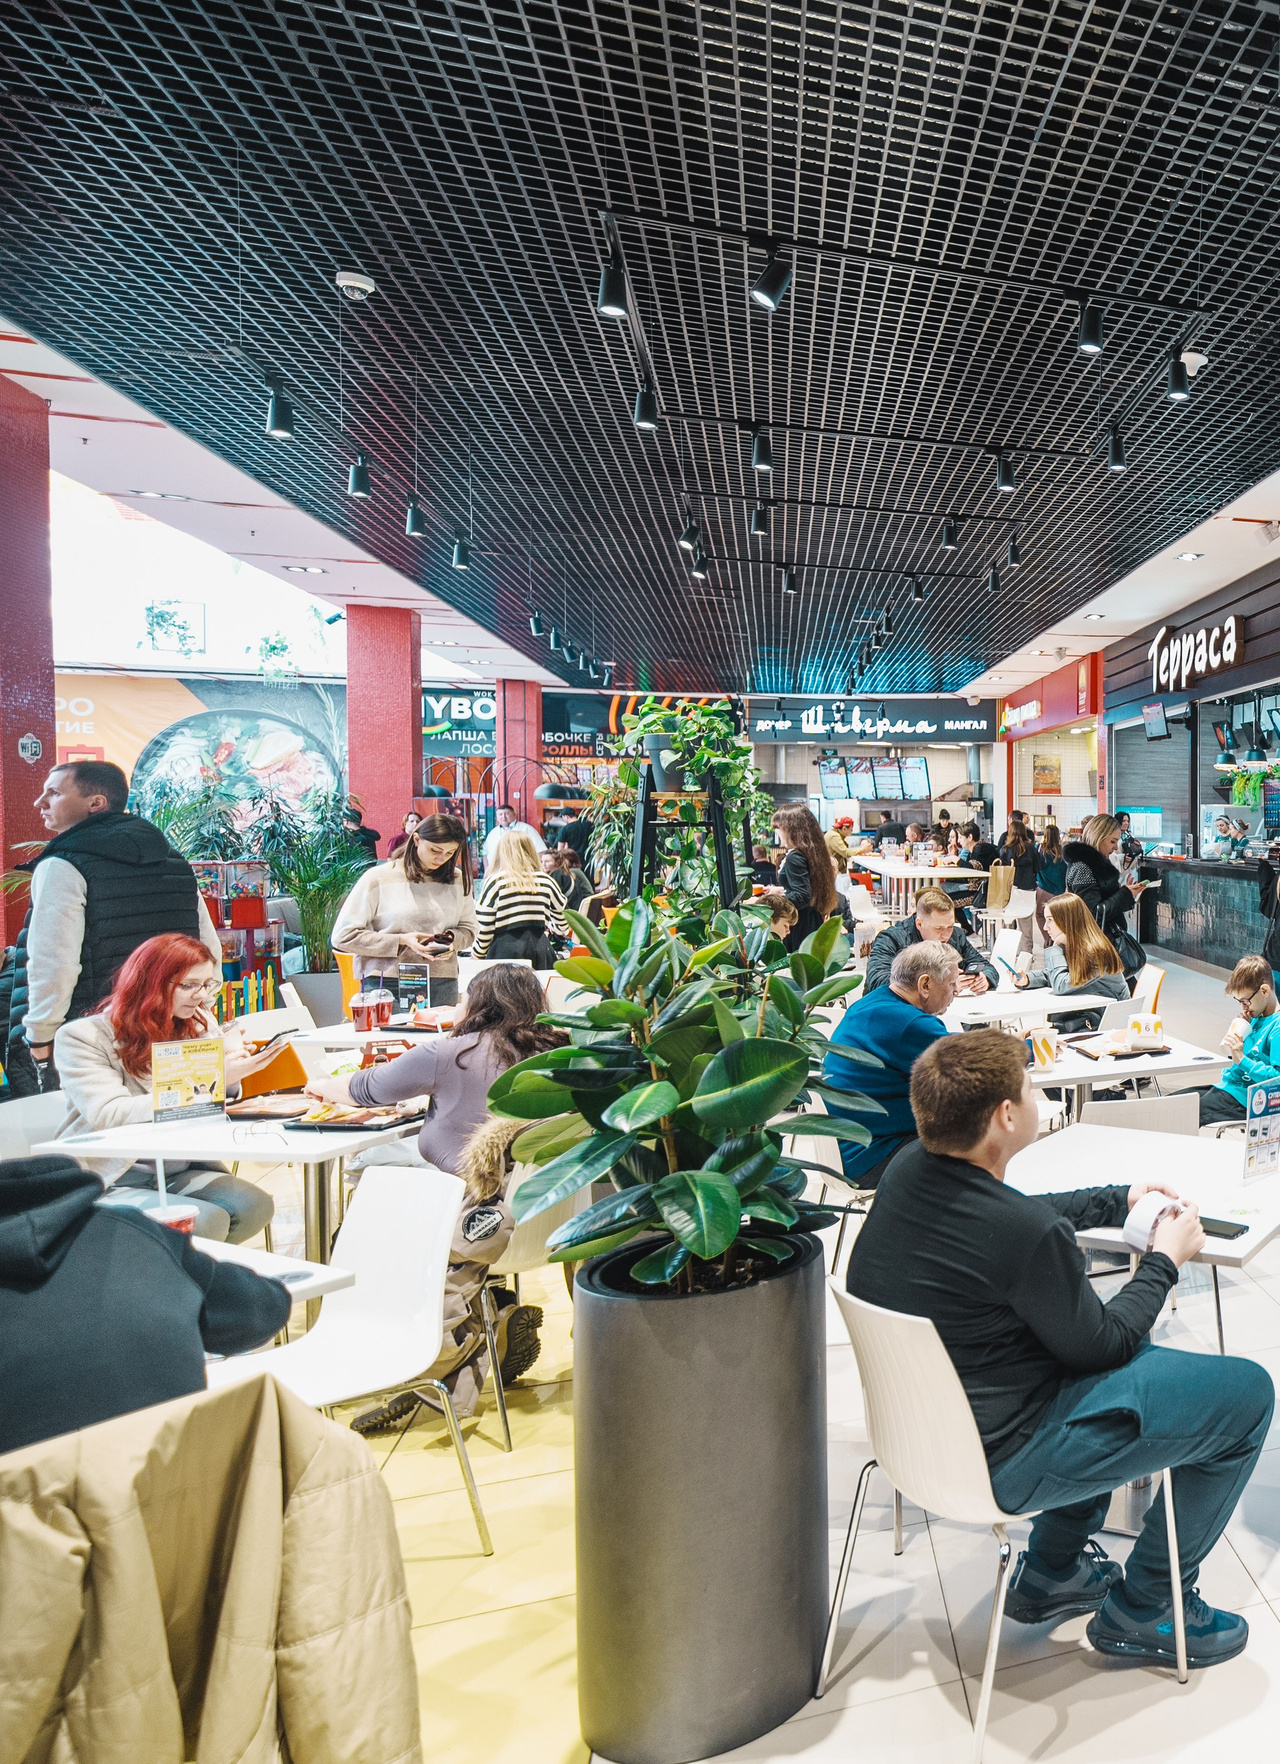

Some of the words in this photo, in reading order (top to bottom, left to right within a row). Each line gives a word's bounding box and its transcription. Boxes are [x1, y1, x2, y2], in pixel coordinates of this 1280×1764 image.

[1148, 614, 1240, 693] Терраса
[421, 695, 497, 720] YBO
[944, 720, 987, 731] МАНГАЛ
[541, 731, 592, 743] БОЧКЕ
[460, 743, 497, 754] ЛОС
